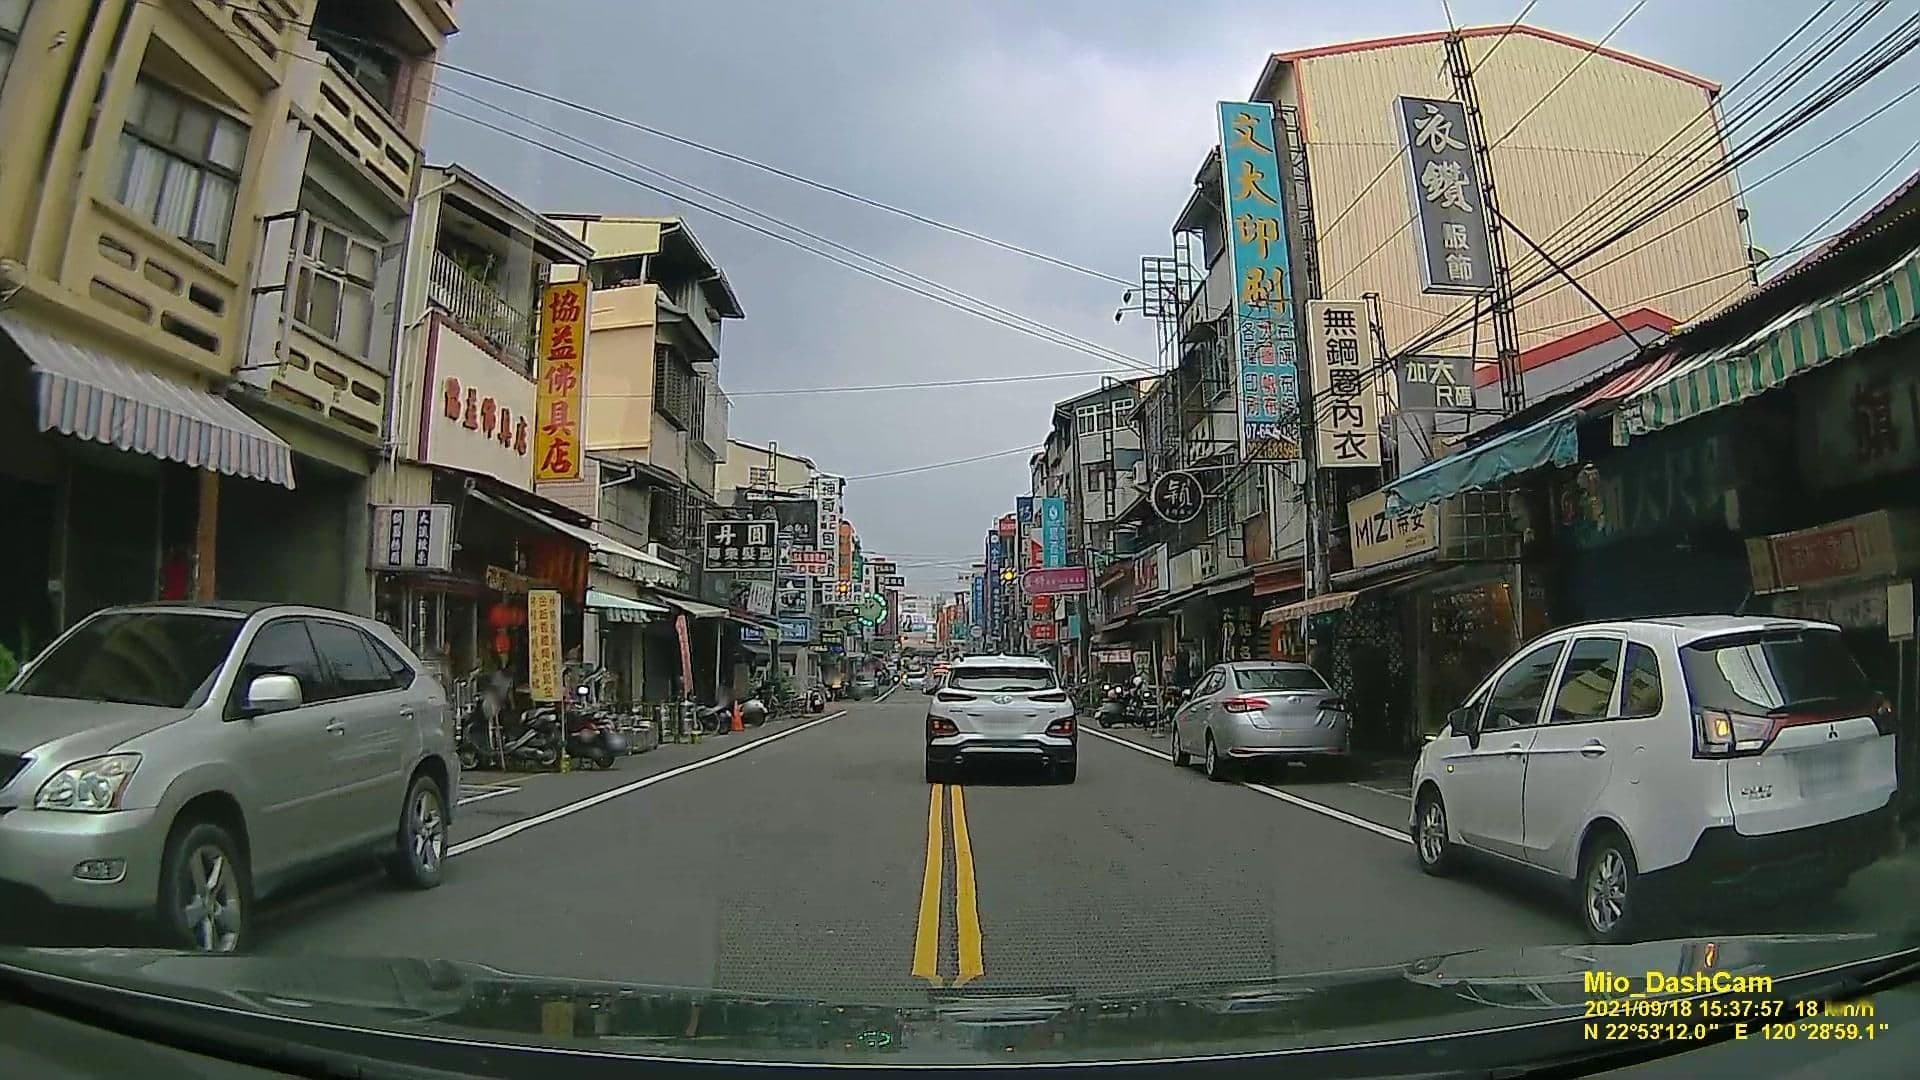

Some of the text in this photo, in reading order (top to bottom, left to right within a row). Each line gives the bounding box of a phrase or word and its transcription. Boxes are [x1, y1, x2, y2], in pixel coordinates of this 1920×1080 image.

[1413, 103, 1473, 214] 衣鑽
[1232, 111, 1286, 316] 文大印刷
[1441, 221, 1474, 282] 服飾
[540, 288, 581, 474] 協益佛具店
[1323, 307, 1368, 461] 無鋼圈內衣
[1405, 360, 1455, 384] 加大
[1436, 385, 1473, 408] 尺碼
[1354, 512, 1394, 549] MIZI
